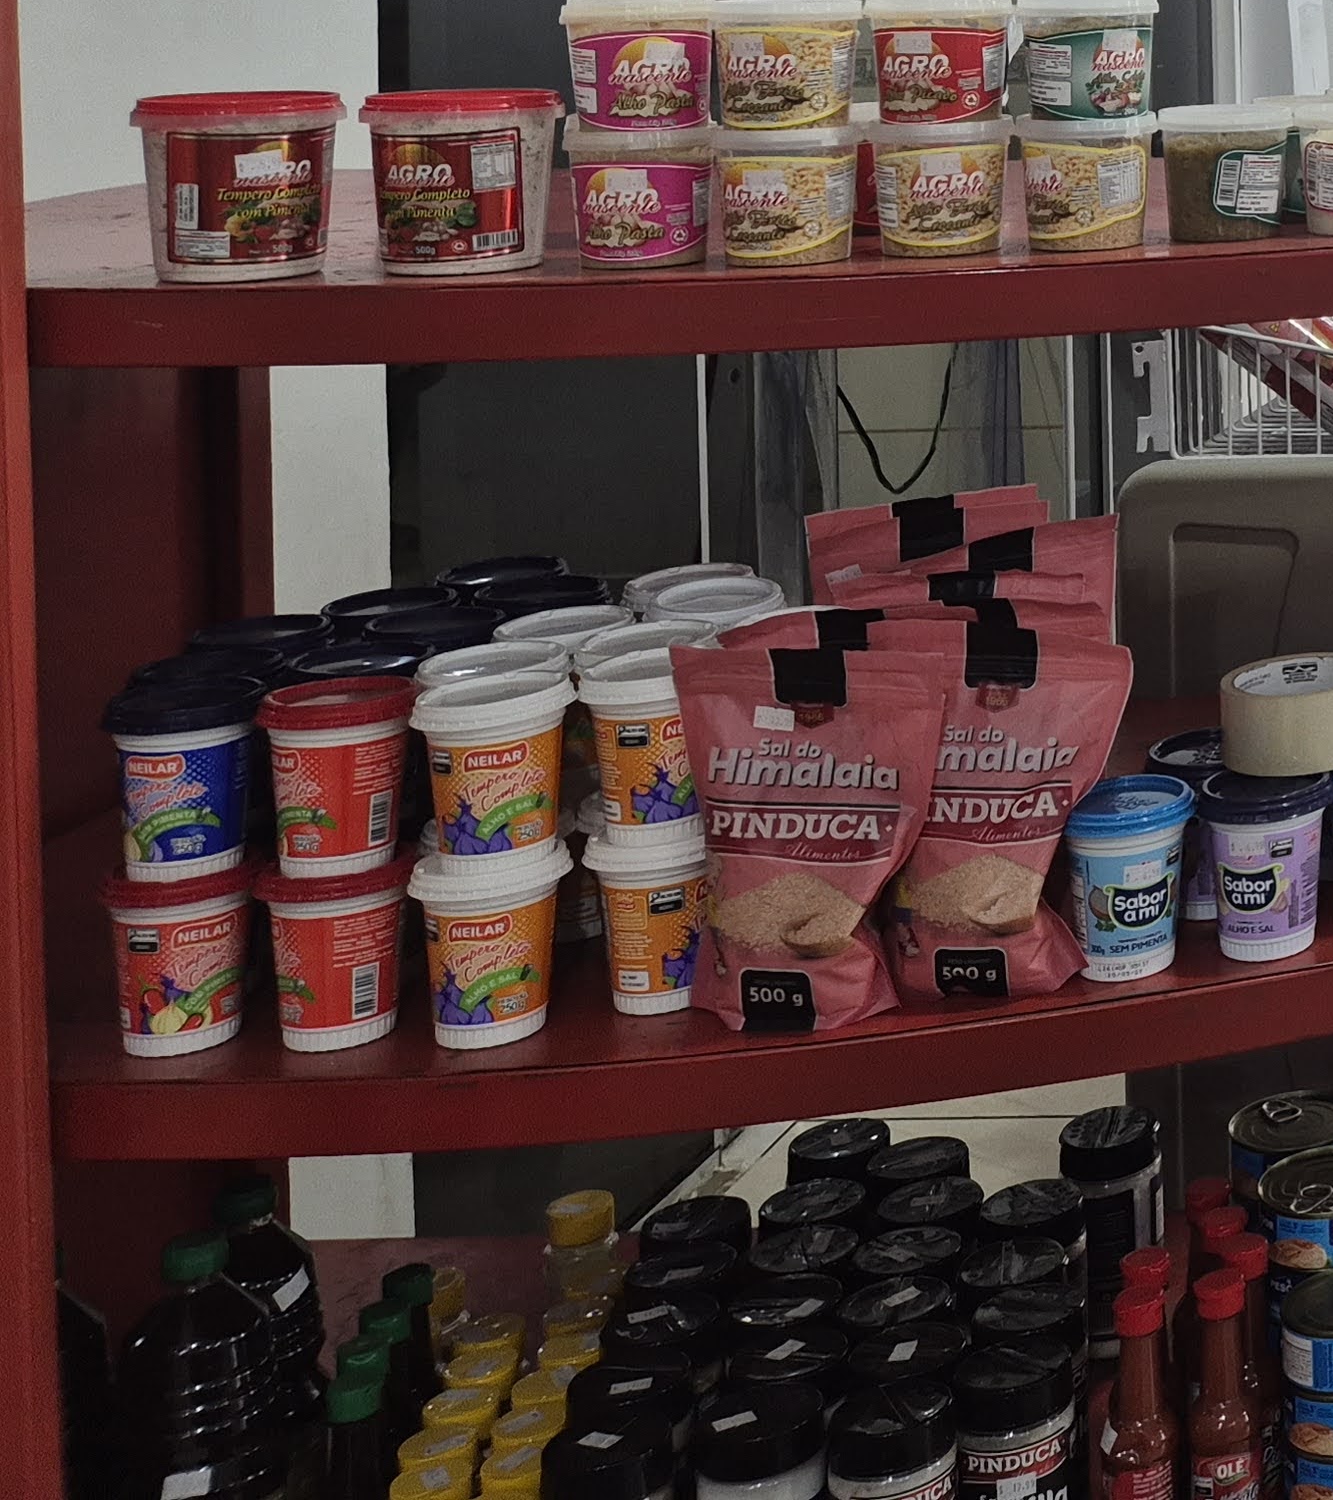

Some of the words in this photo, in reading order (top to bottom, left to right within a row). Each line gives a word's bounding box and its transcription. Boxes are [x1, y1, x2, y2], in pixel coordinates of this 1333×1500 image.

[883, 54, 950, 72] AGRO
[388, 163, 452, 181] AGRO
[912, 173, 984, 191] AGRO
[217, 187, 272, 203] Tempero
[943, 726, 970, 743] Sal
[973, 727, 1004, 743] do
[758, 738, 791, 759] Sal
[795, 741, 821, 759] do
[128, 761, 176, 775] NEILAR
[467, 751, 525, 769] NEILAR
[708, 748, 899, 791] Himalaia
[710, 811, 881, 842] PINDUCA
[784, 844, 862, 862] Alimentos
[1224, 876, 1272, 893] Sabor
[1114, 887, 1167, 911] Sabor
[1231, 890, 1266, 906] ami
[1123, 905, 1159, 922] ami
[178, 923, 231, 943] NEILAR
[451, 922, 506, 939] NEILAR
[1228, 925, 1250, 934] ALHO
[1257, 924, 1276, 933] SAL
[1110, 942, 1129, 954] SEM
[1130, 934, 1168, 952] PIMENTA
[749, 986, 787, 1006] 500
[968, 1440, 1061, 1472] PINDUCA
